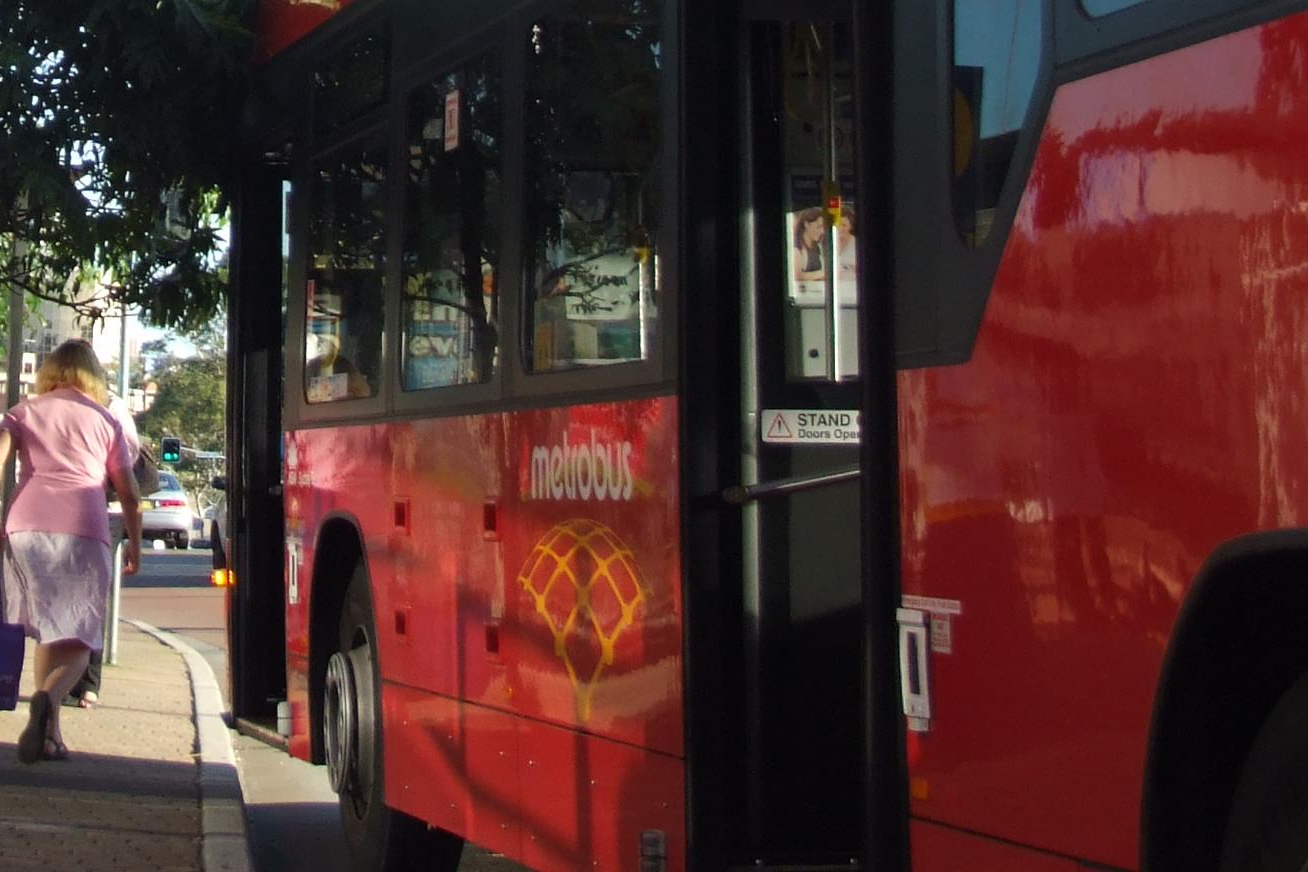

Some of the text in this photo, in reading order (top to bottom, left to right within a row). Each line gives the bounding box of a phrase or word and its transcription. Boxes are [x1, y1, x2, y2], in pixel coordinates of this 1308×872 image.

[797, 413, 851, 427] STAND
[798, 429, 831, 439] Doors
[532, 428, 632, 501] metrobus
